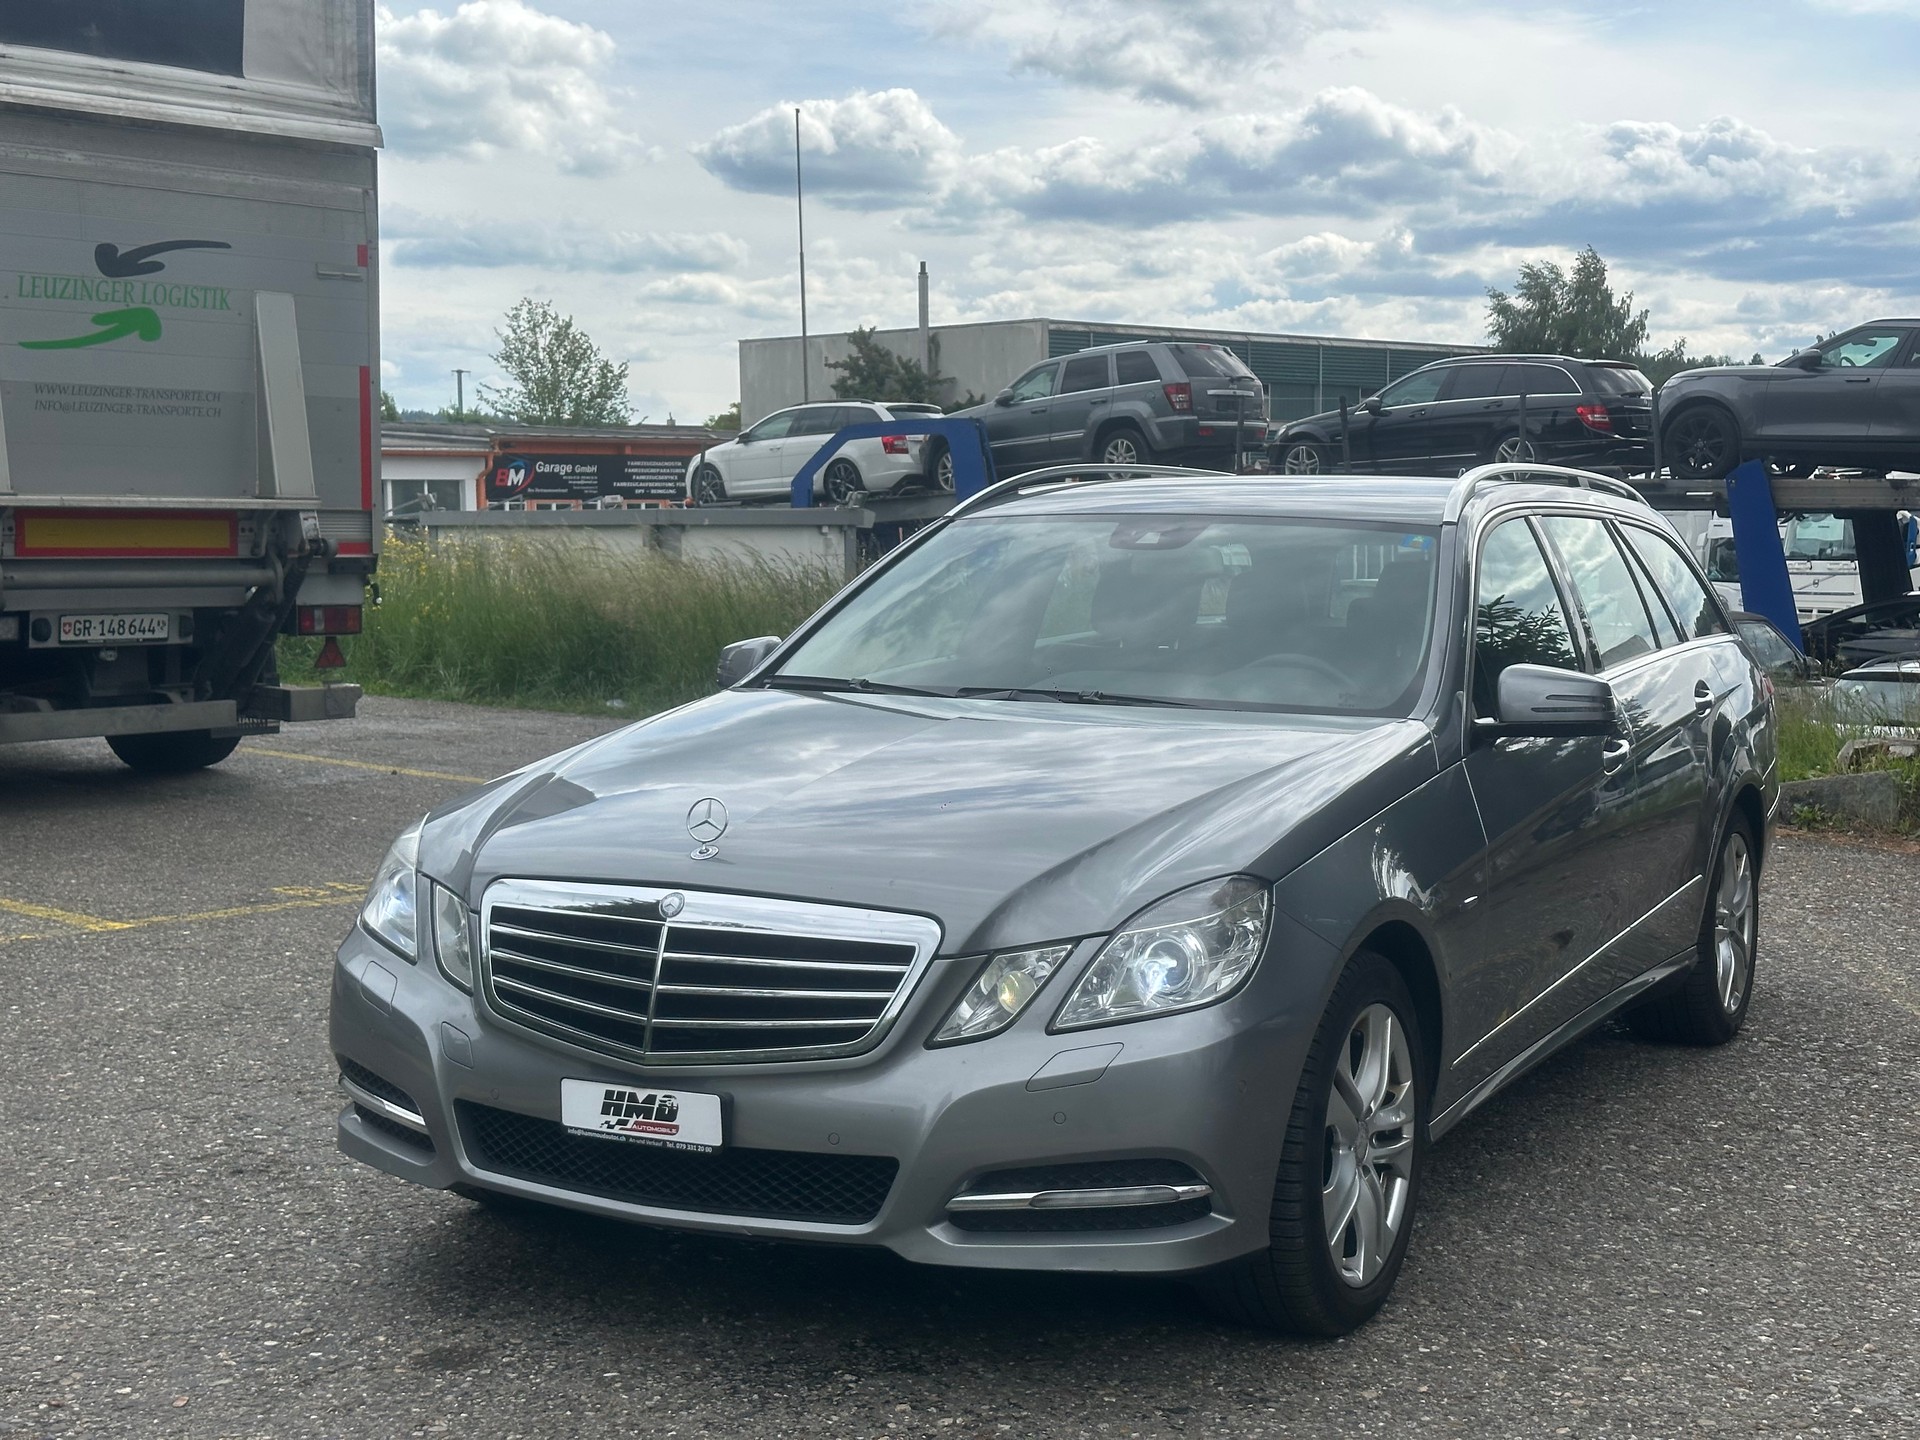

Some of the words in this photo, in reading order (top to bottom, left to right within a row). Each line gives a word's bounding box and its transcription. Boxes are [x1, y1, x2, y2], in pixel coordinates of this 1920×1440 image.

[18, 274, 134, 304] LEUZINGER
[141, 282, 231, 311] LOGISTIK
[34, 384, 222, 403] WWW.LEUZINGER-TRANSPORTE.CH
[34, 400, 222, 418] INFO@LEUZINGER-TRANSPORTE.CH
[535, 461, 573, 475] Garage
[574, 464, 598, 473] GmbH
[495, 468, 525, 487] BM
[632, 1124, 677, 1134] AUTOMOBILE
